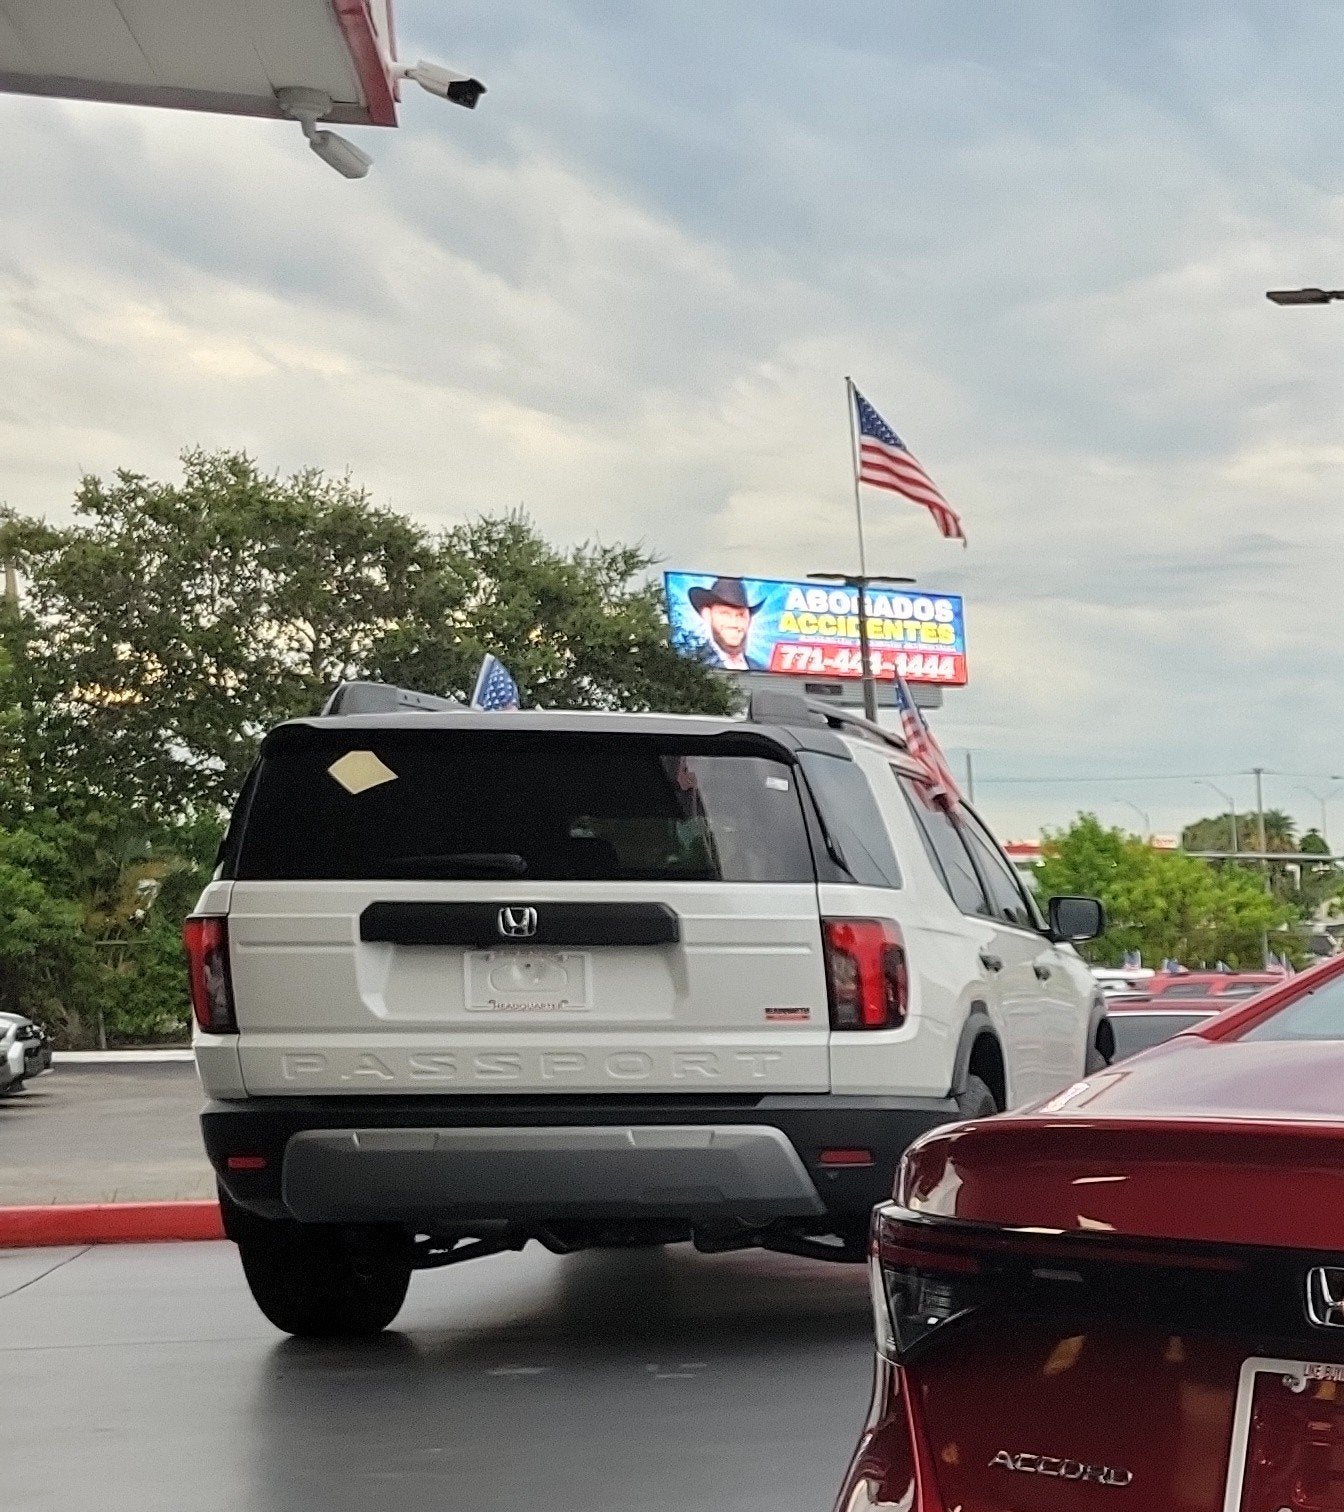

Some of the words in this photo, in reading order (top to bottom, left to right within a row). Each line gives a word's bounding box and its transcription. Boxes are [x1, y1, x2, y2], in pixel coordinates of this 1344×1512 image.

[779, 611, 956, 645] ACCIDENTES
[281, 1050, 784, 1081] PASSPORT
[988, 1450, 1133, 1486] ACCORD
